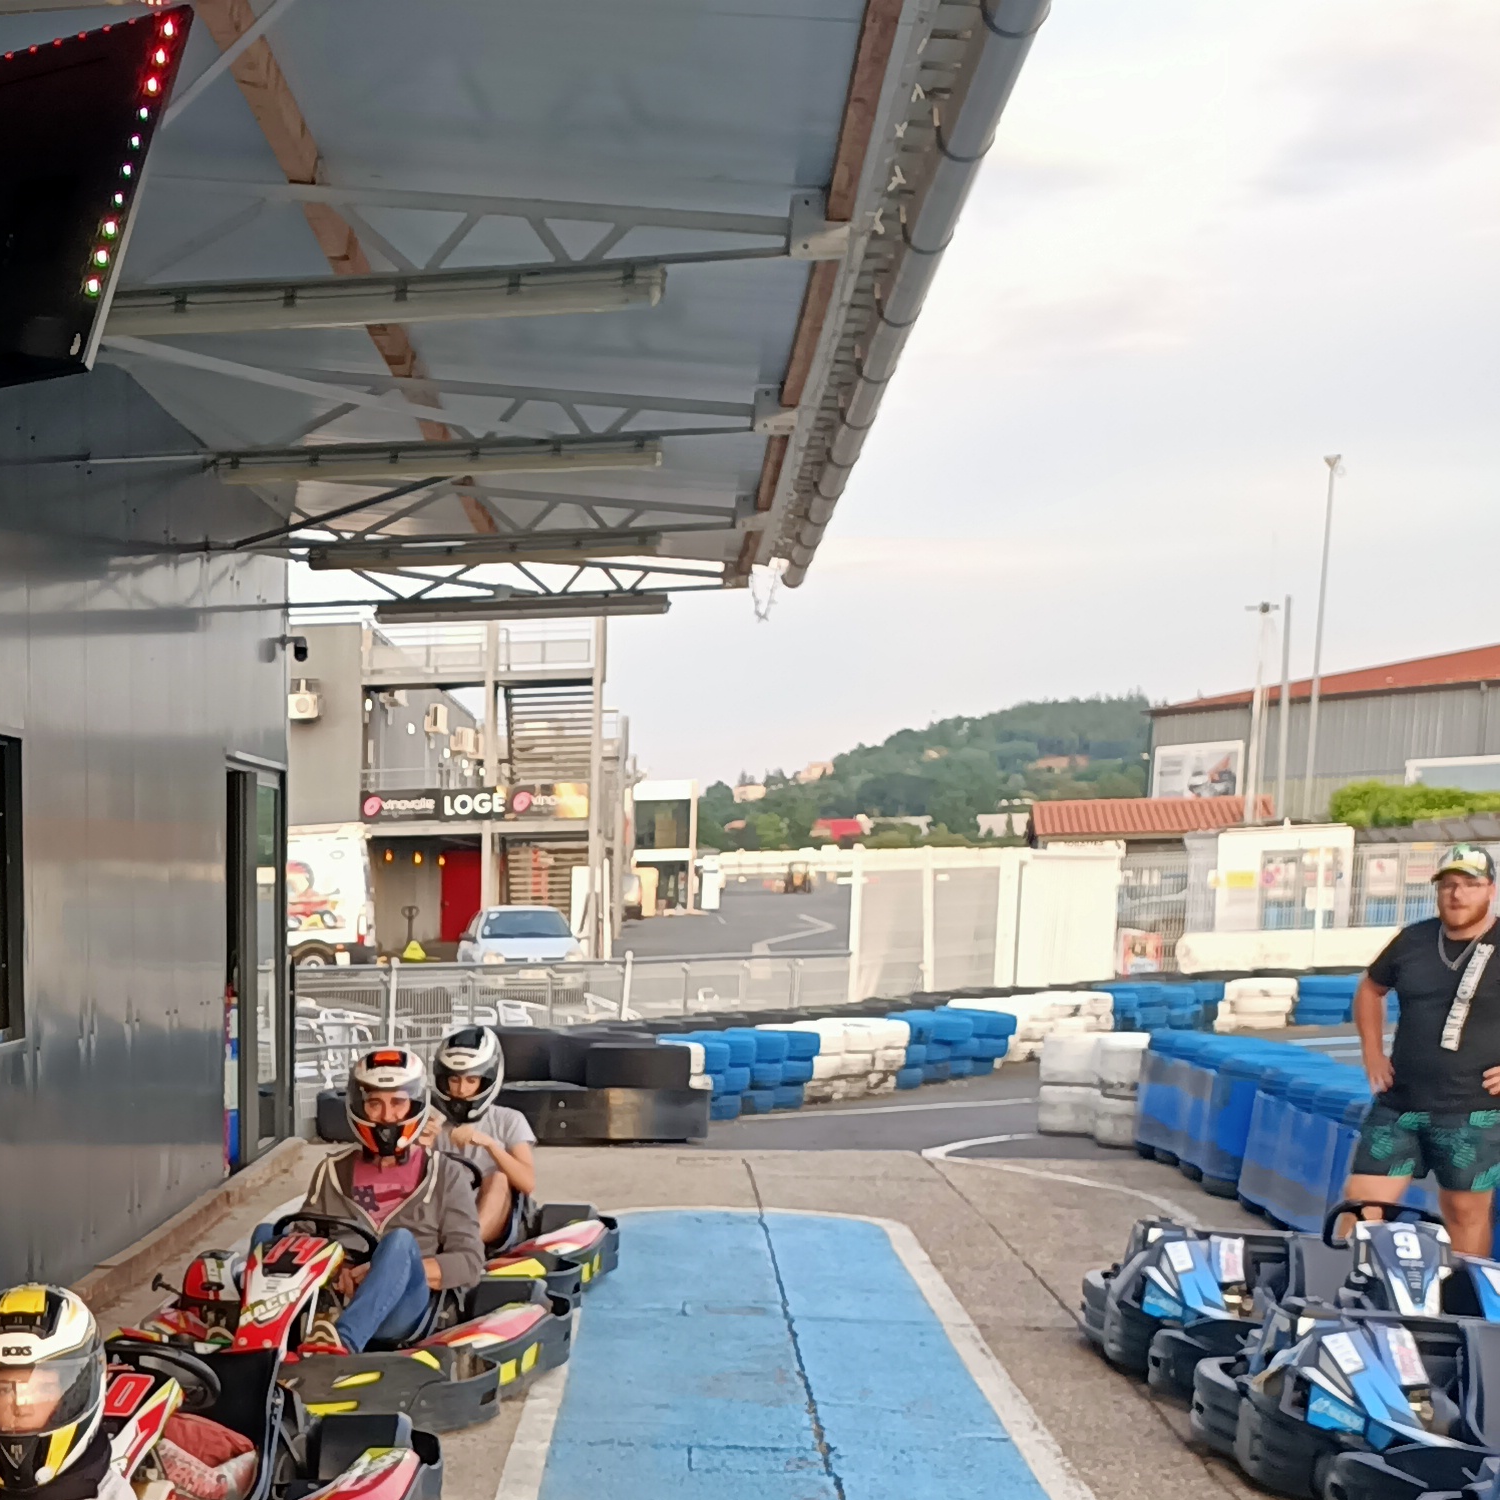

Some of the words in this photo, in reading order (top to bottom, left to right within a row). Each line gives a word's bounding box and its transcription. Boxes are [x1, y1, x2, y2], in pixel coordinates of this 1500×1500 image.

[443, 792, 506, 816] LOGE
[262, 1236, 329, 1264] 14
[1393, 1231, 1422, 1259] 9
[104, 1372, 155, 1417] 0
